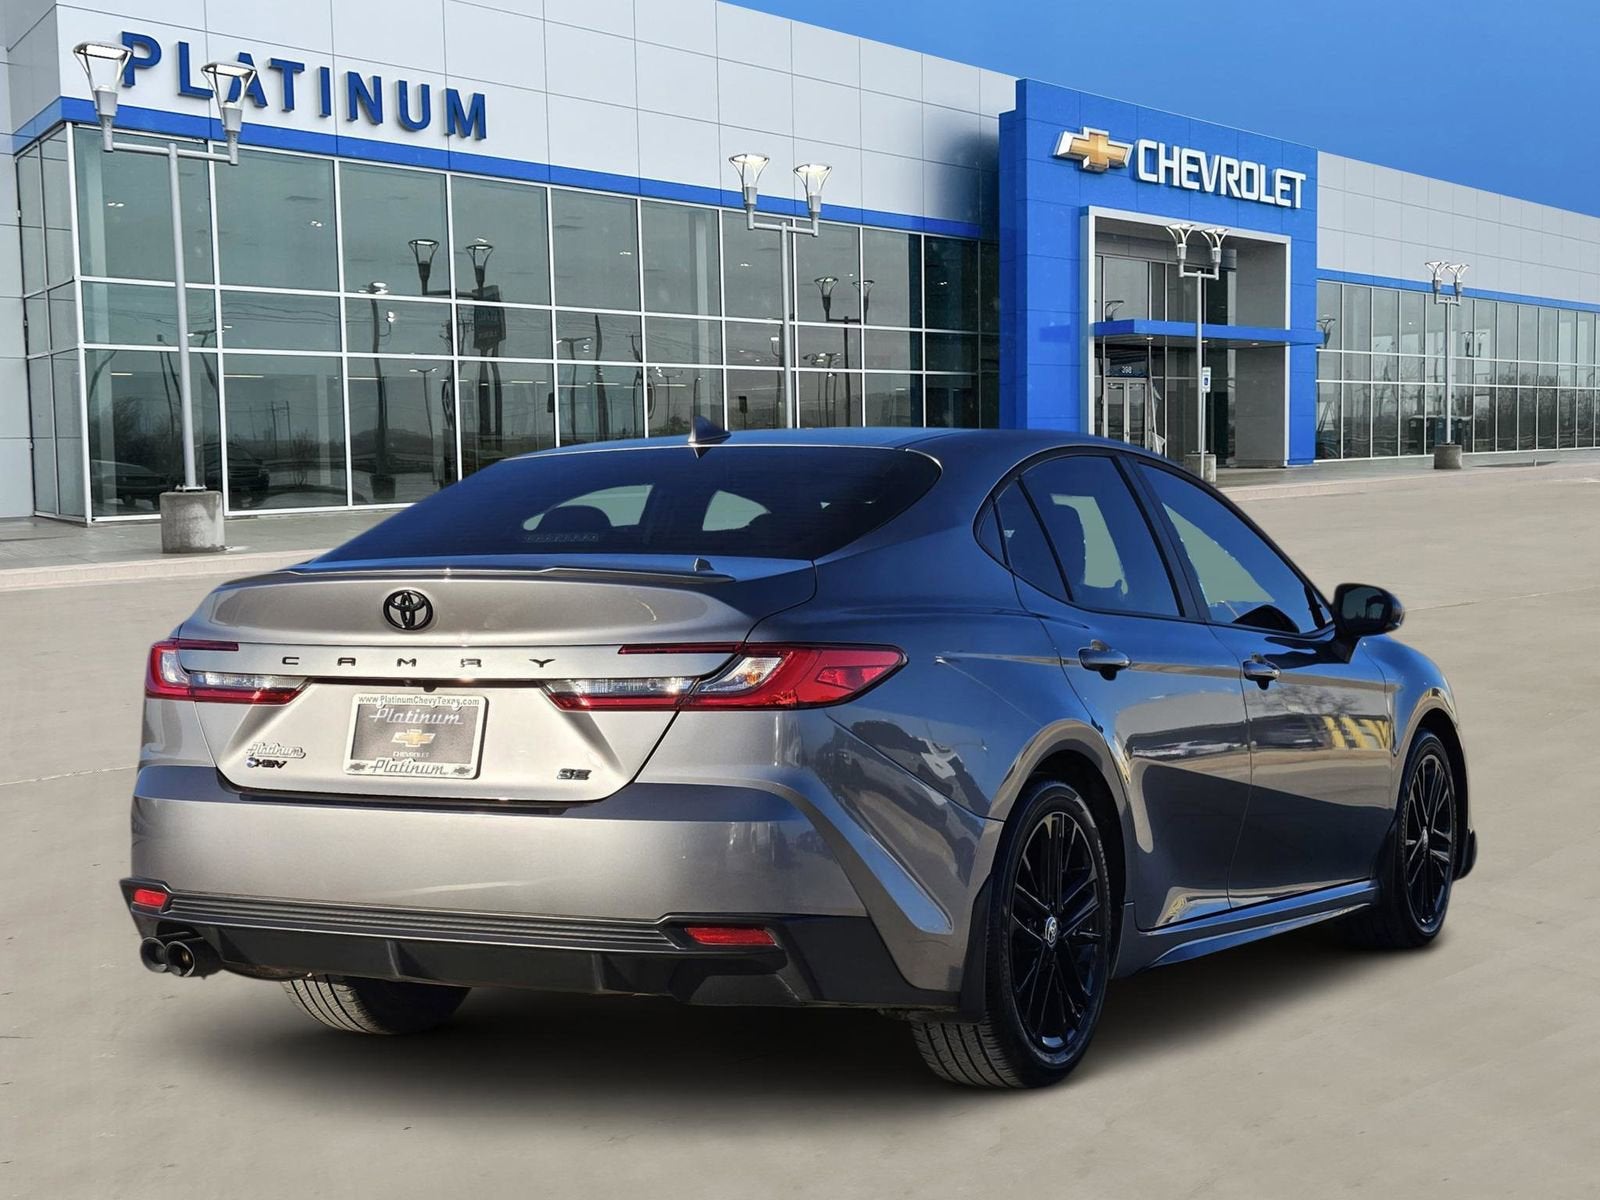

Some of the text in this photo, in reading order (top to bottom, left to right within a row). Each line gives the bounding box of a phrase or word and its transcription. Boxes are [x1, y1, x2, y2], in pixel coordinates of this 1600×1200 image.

[120, 31, 487, 140] PLATINUM
[1136, 138, 1306, 209] CHEVROLET
[281, 656, 556, 668] CAMRY
[369, 707, 464, 725] Platinum
[369, 759, 449, 776] Platinum
[556, 768, 592, 781] SE
